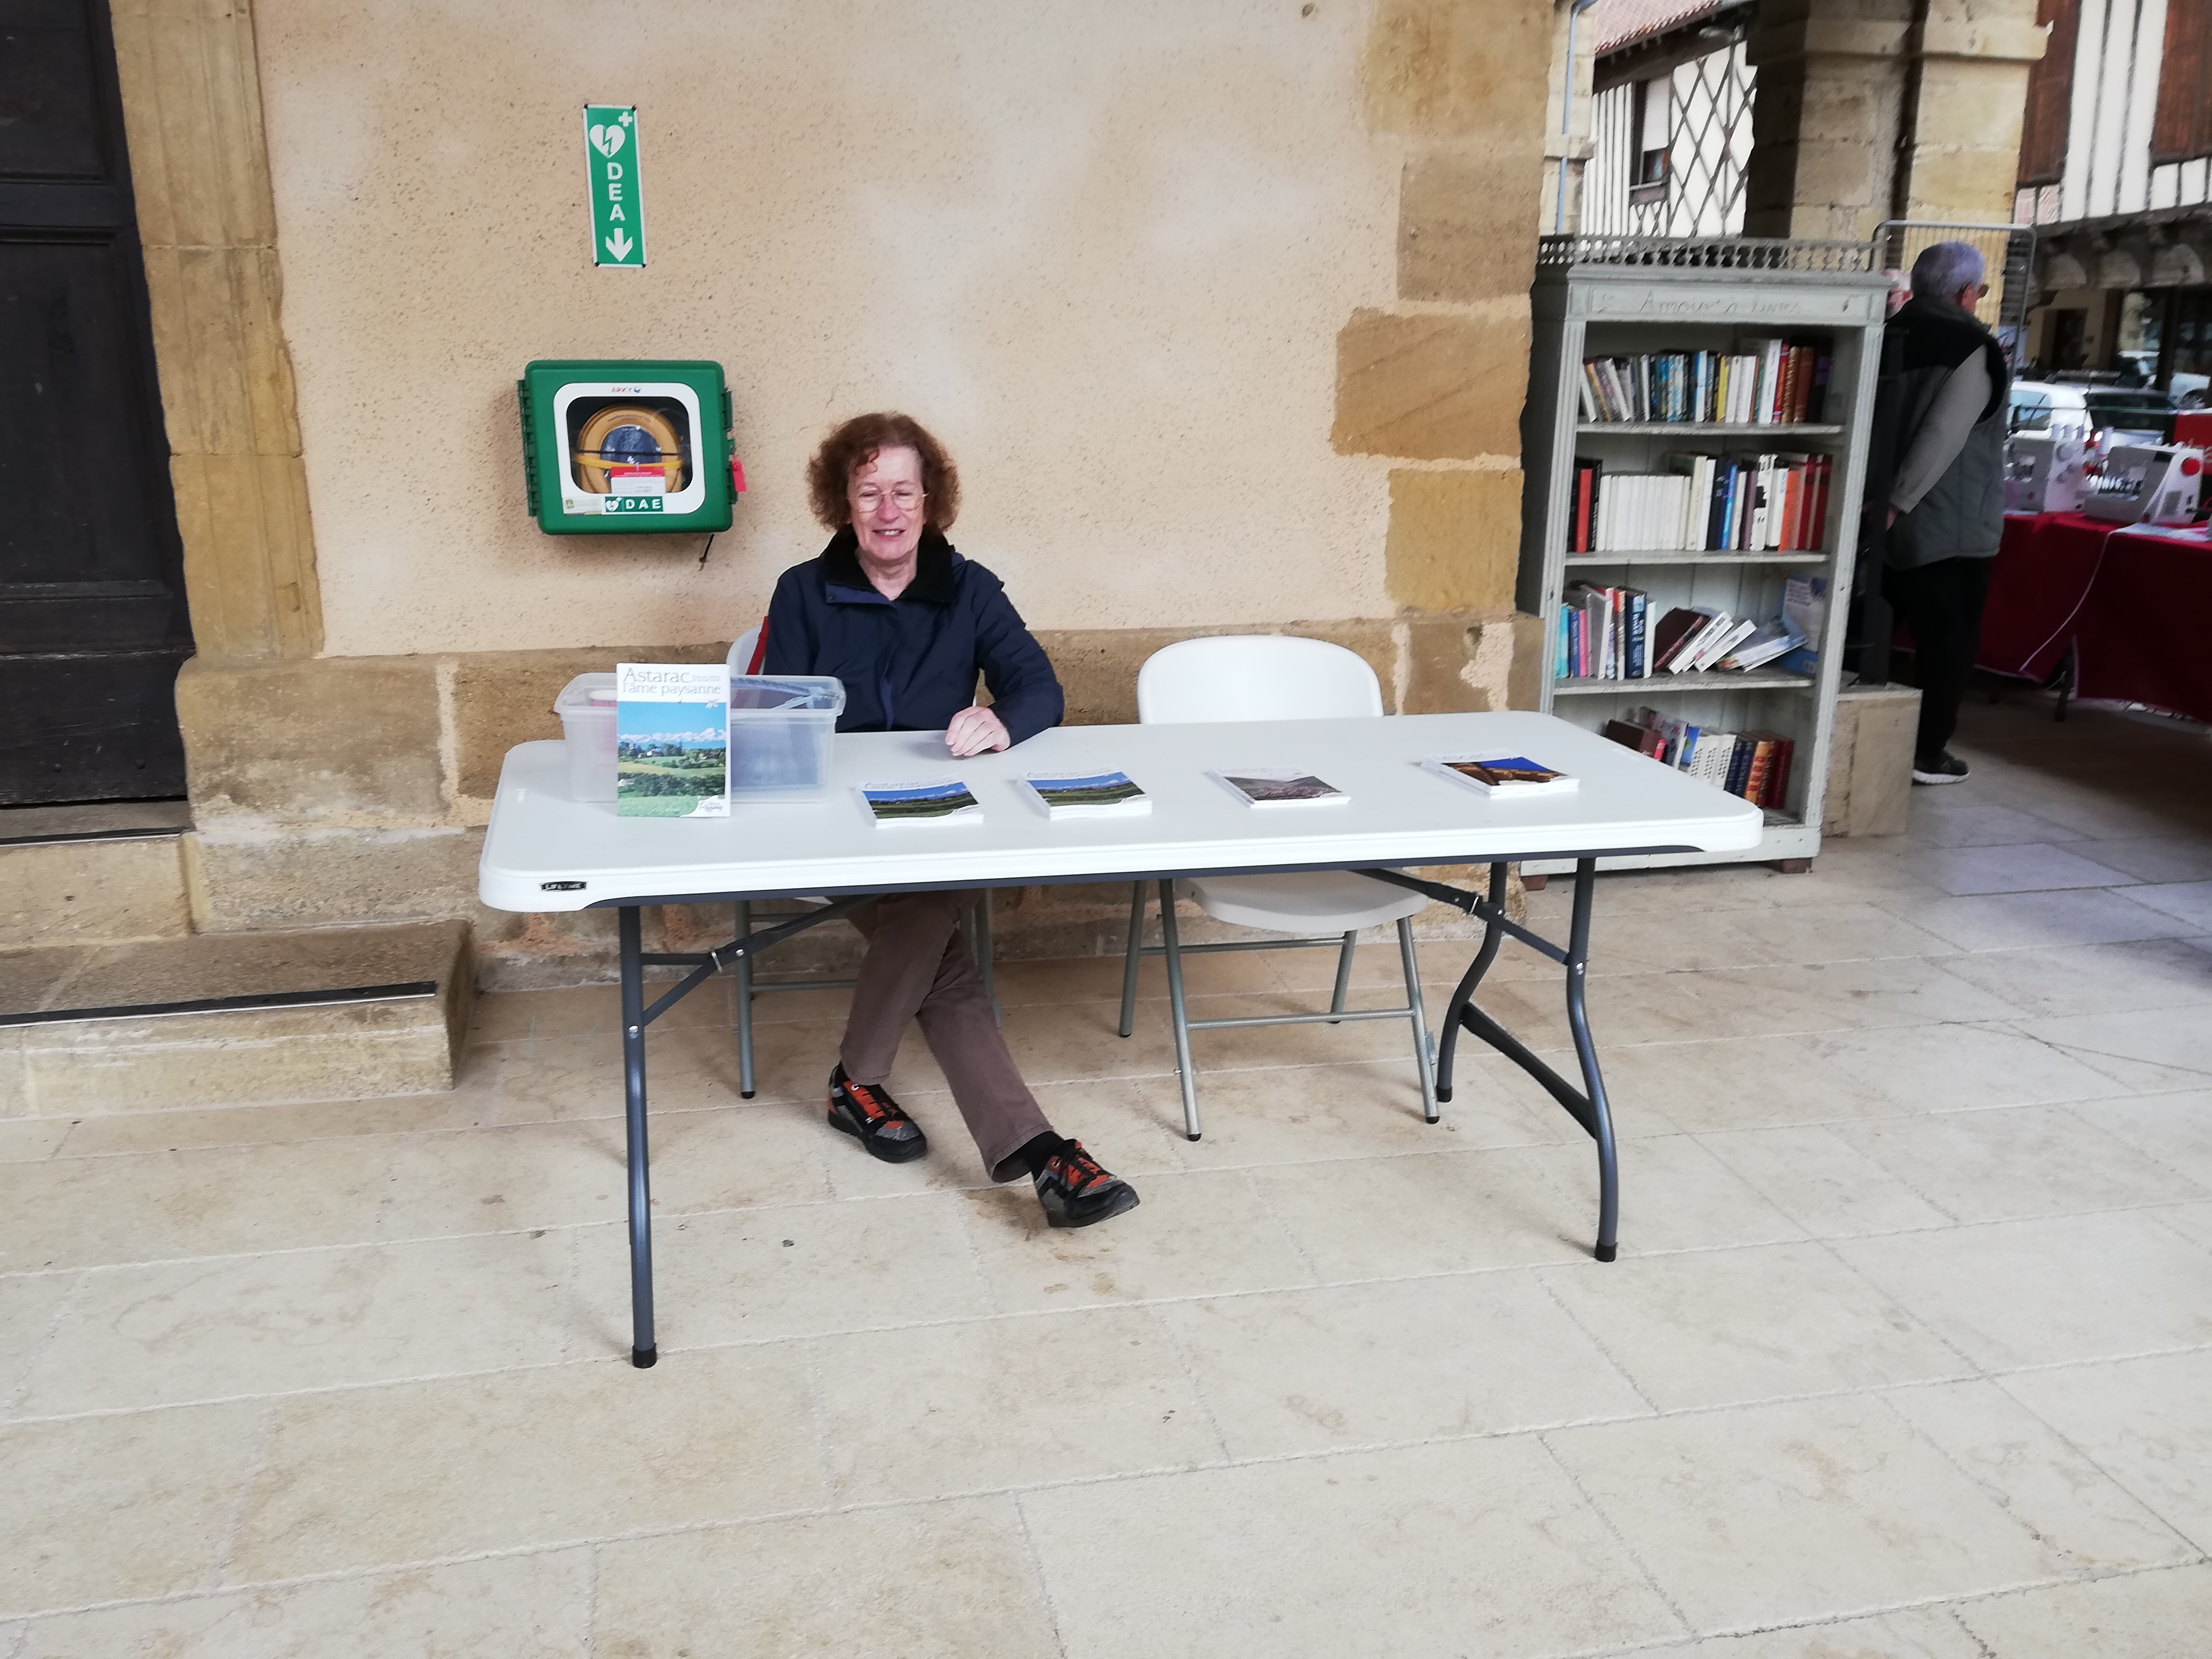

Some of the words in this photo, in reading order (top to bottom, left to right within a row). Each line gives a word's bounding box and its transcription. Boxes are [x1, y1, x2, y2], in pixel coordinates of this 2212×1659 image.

[607, 162, 625, 221] DEA
[625, 499, 661, 510] DAE
[661, 685, 722, 697] paysanne
